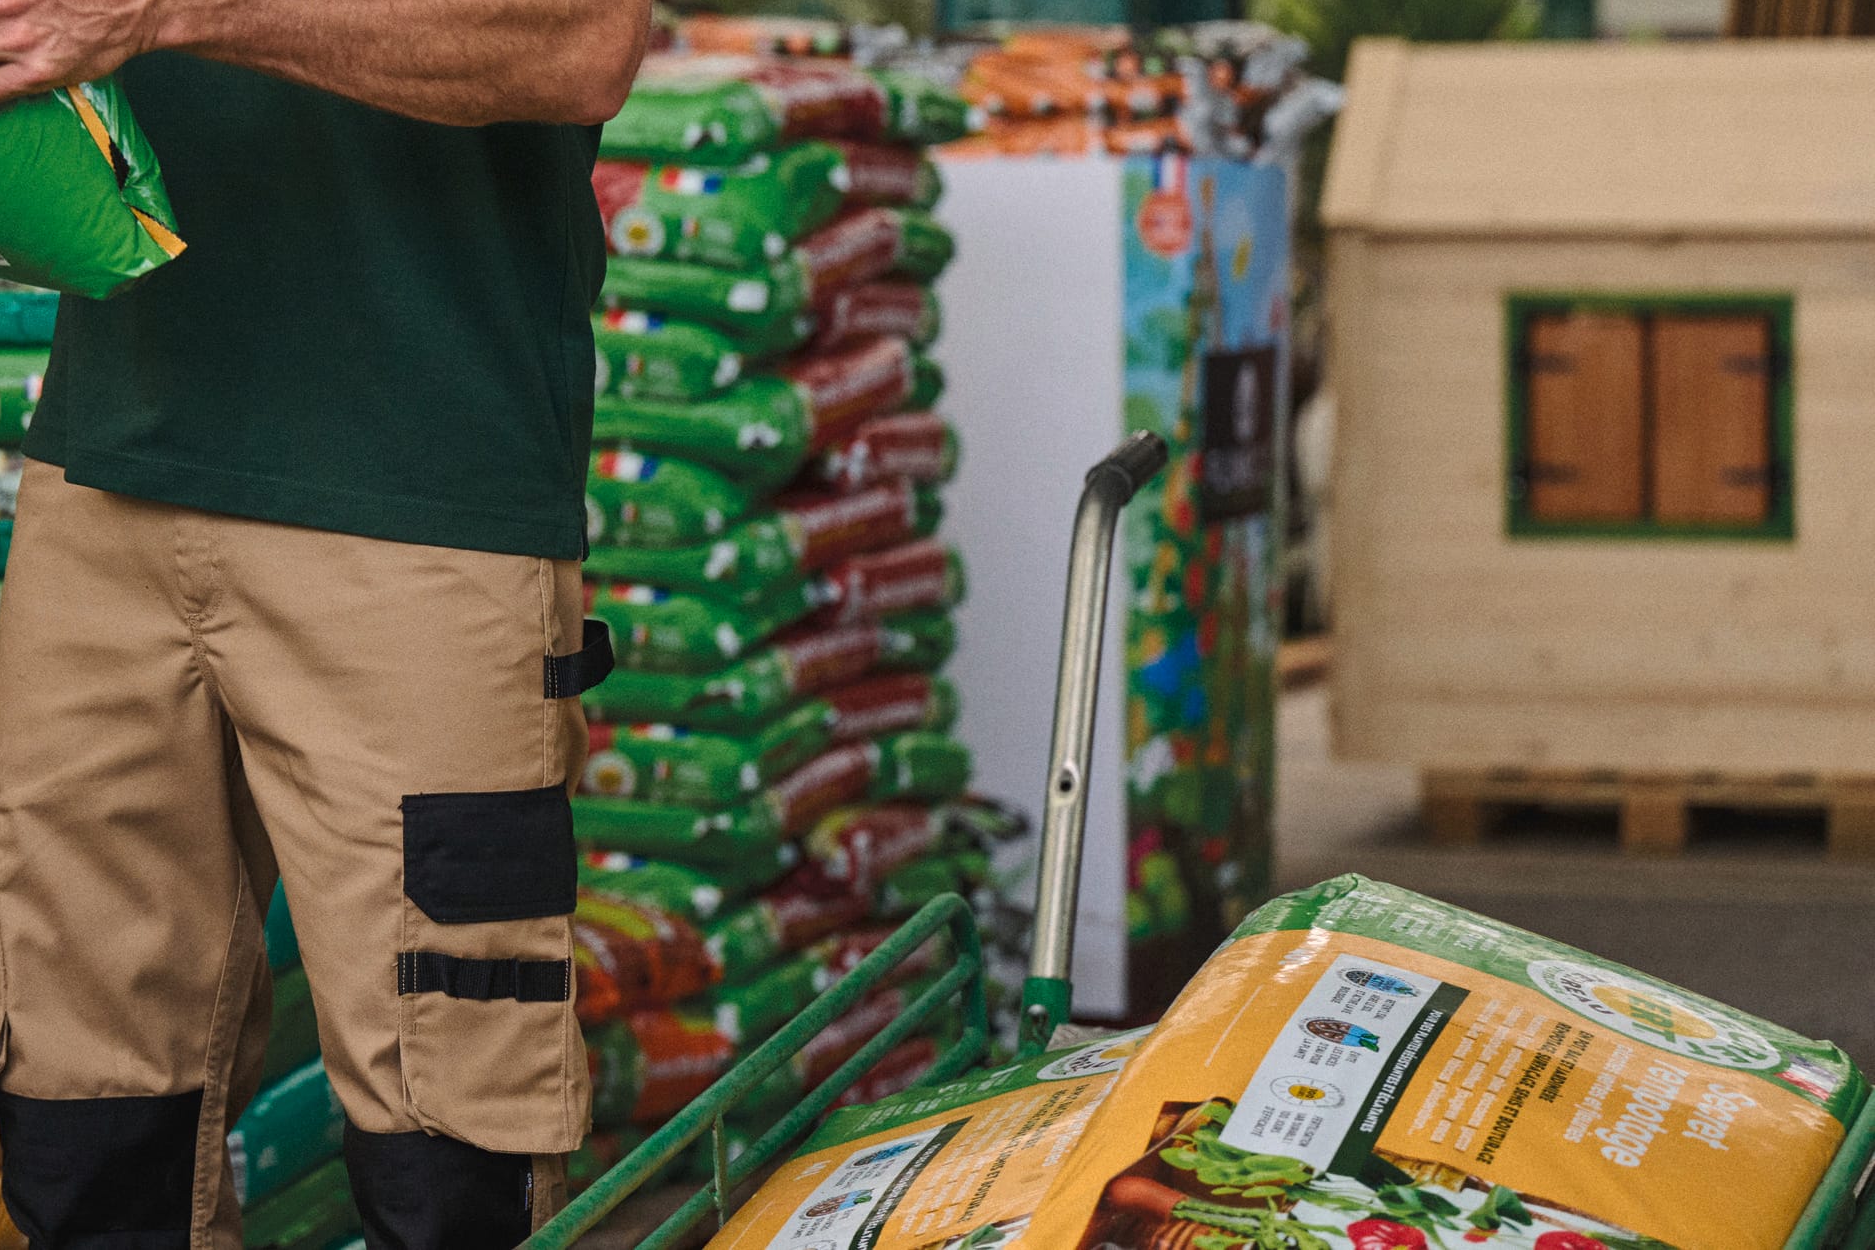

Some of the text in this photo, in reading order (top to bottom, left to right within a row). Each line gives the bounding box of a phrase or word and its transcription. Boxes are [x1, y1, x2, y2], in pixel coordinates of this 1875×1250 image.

[1420, 1021, 1435, 1032] DES
[1426, 1009, 1443, 1024] POUR
[1406, 1030, 1429, 1052] PLANTES
[1386, 1048, 1419, 1086] RÉSISTANTES
[1537, 1065, 1574, 1104] JARDINIÈRE
[1358, 1091, 1395, 1134] ÉCLATANTES
[1501, 1105, 1518, 1116] ET
[1507, 1086, 1530, 1107] SEMIS
[1595, 1058, 1690, 1168] rempotage
[1682, 1082, 1757, 1151] Secret
[1475, 1115, 1513, 1164] BOUTURAGE
